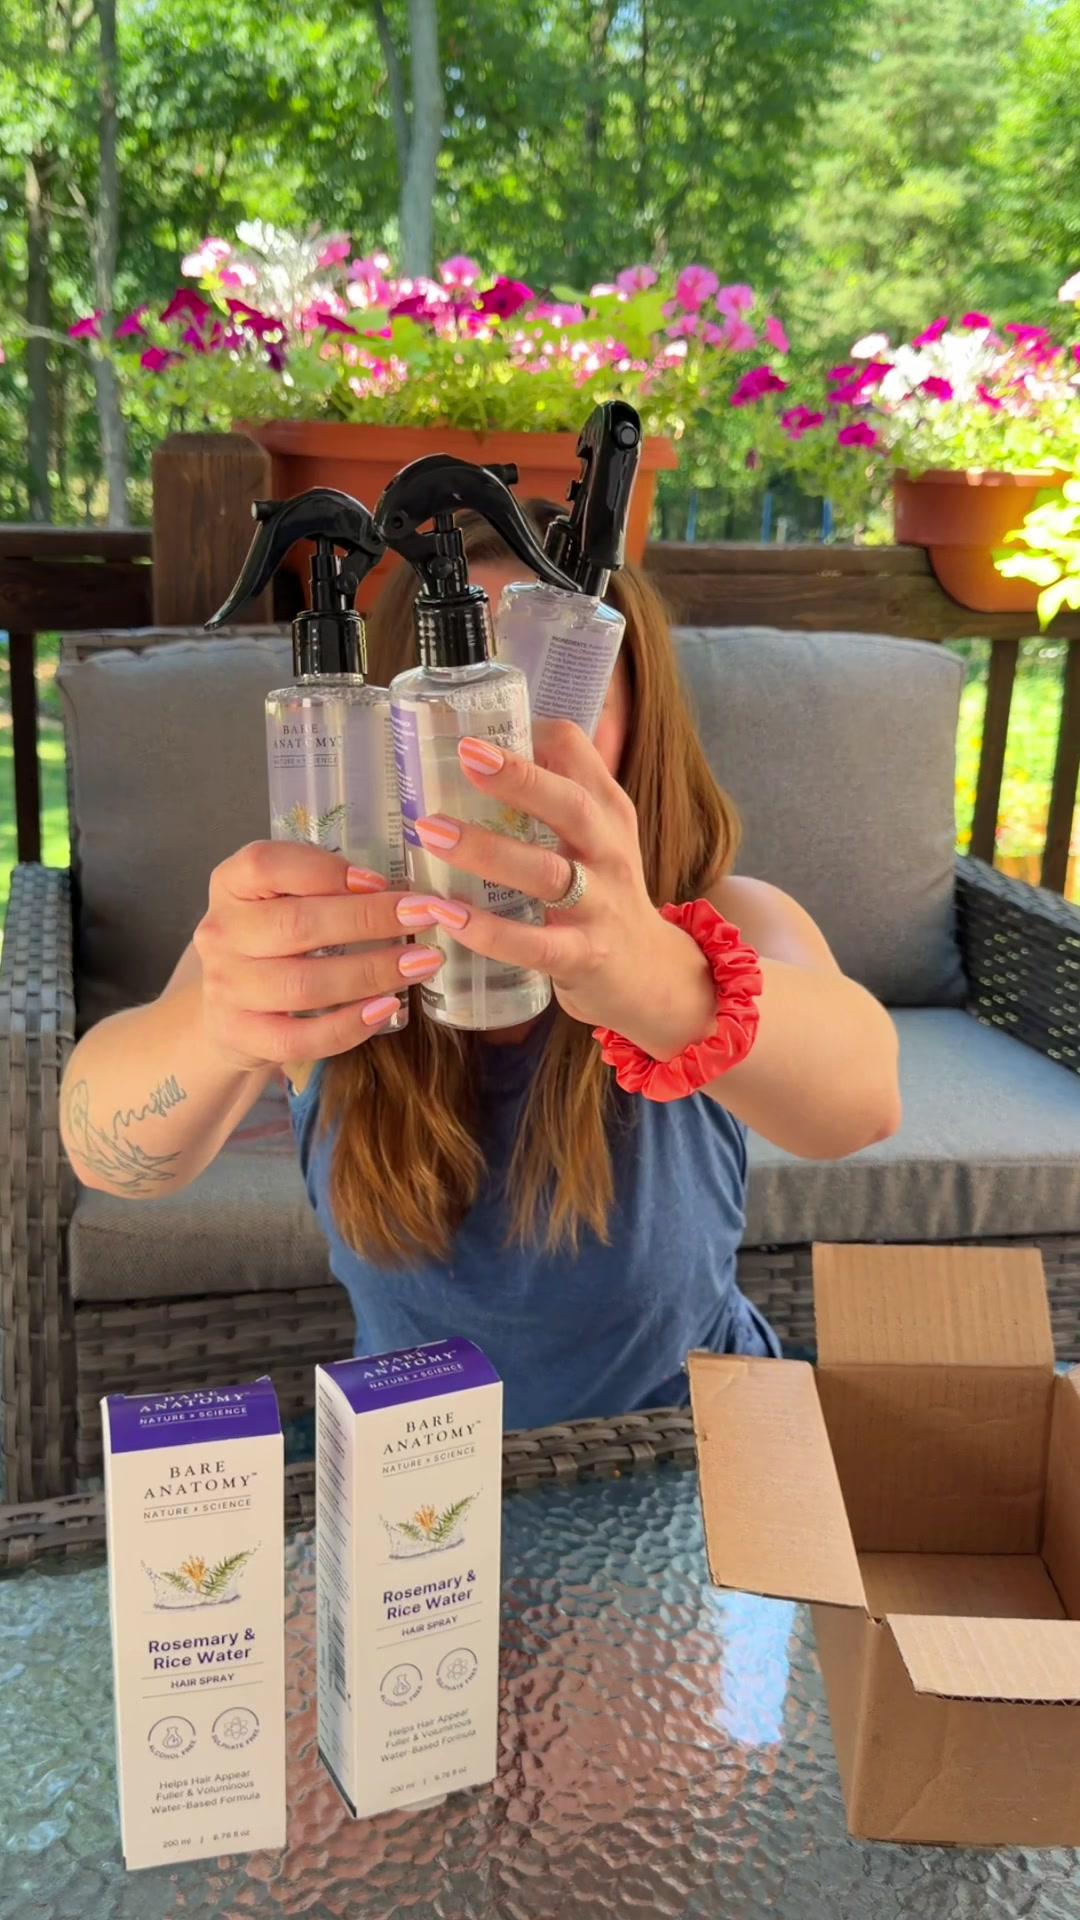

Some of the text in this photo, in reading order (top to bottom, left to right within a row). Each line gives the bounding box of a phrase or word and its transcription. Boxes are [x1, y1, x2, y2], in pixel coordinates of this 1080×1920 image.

[273, 736, 337, 749] ANATMY
[378, 1351, 428, 1366] BARE
[369, 1375, 410, 1389] NATURE
[420, 1362, 464, 1378] SCIENCE
[139, 1414, 186, 1425] NATURE
[198, 1406, 248, 1418] SCIENCE
[405, 1411, 455, 1433] BARE
[169, 1460, 226, 1479] BARE
[382, 1459, 422, 1474] NATURE
[433, 1446, 476, 1463] SCIENCE
[143, 1505, 190, 1520] NATURE
[202, 1498, 251, 1512] SCIENCE
[383, 1569, 477, 1604] Rosemary &
[387, 1588, 473, 1620] Rice Water
[401, 1615, 459, 1637] HAIR SPRAY
[148, 1627, 255, 1653] Rosemary &
[153, 1647, 252, 1670] Rice Water
[170, 1673, 235, 1689] HAIR SPRAY
[388, 1708, 470, 1737] Helps Hair Appear
[421, 1718, 473, 1739] Voluminous
[440, 1728, 477, 1745] Formula
[155, 1780, 255, 1801] Fuller & Voluminous
[159, 1769, 251, 1790] Helps Hair Appear
[150, 1791, 261, 1814] Water-Based Formula
